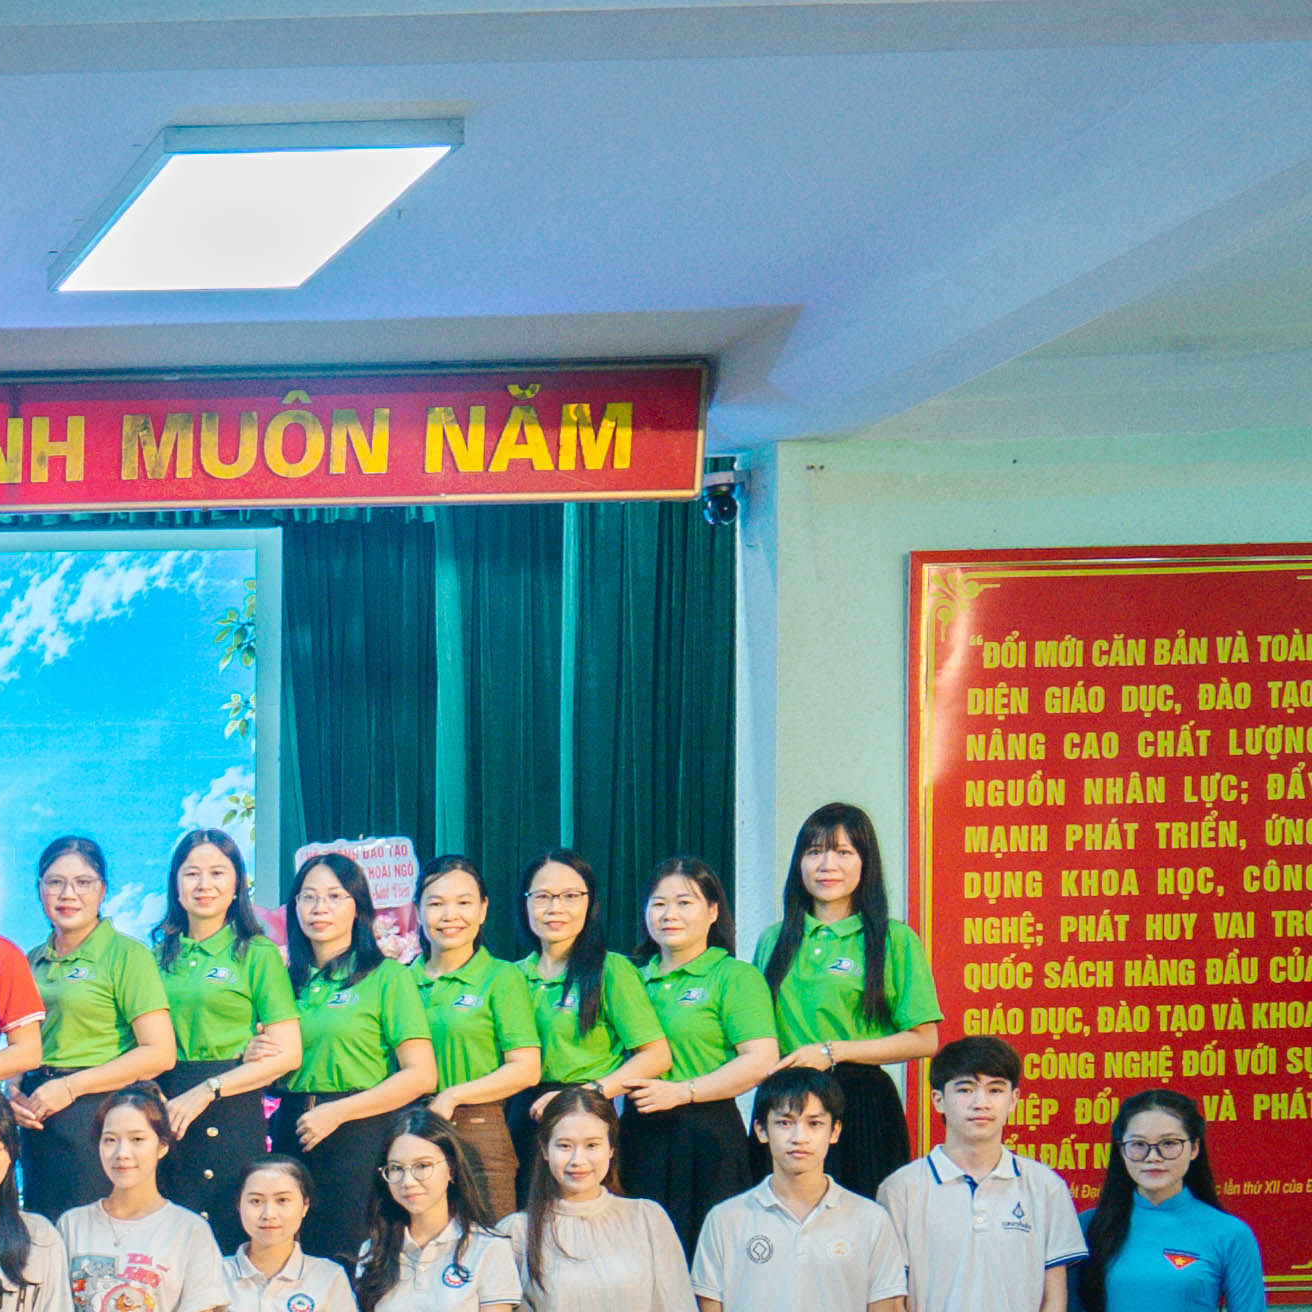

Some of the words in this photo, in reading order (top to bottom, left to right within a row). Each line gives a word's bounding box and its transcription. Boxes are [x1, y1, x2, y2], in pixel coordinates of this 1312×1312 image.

[122, 391, 389, 480] MUÔN
[423, 382, 634, 473] NĂM
[1034, 634, 1084, 668] MỚI
[1092, 634, 1146, 667] CĂN
[1153, 628, 1209, 666] BẢN
[1215, 630, 1249, 664] VÀ
[967, 681, 1029, 721] DIỆN
[1044, 680, 1105, 714] GIÁO
[1121, 684, 1182, 718] DỤC,
[1197, 677, 1252, 711] ĐÀO
[966, 728, 1046, 761] NÂNG
[1063, 731, 1119, 760] CAO
[1137, 721, 1212, 758] CHẤT
[965, 770, 1065, 807] NGUỒN
[1084, 771, 1166, 805] NHÂN
[1184, 772, 1249, 808] LỰC;
[965, 824, 1048, 859] MẠNH
[1065, 817, 1139, 851] PHÁT
[1155, 813, 1247, 850] TRIỂN,
[964, 870, 1043, 905] DỤNG
[1061, 868, 1139, 897] KHOA
[1157, 866, 1225, 900] HỌC,
[964, 911, 1044, 949] NGHỆ;
[1060, 909, 1130, 943] PHÁT
[1145, 913, 1197, 941] HUY
[1213, 911, 1255, 939] VAI
[964, 953, 1033, 993] QUỐC
[1264, 1179, 1281, 1194] XII
[1282, 1179, 1303, 1194] của
